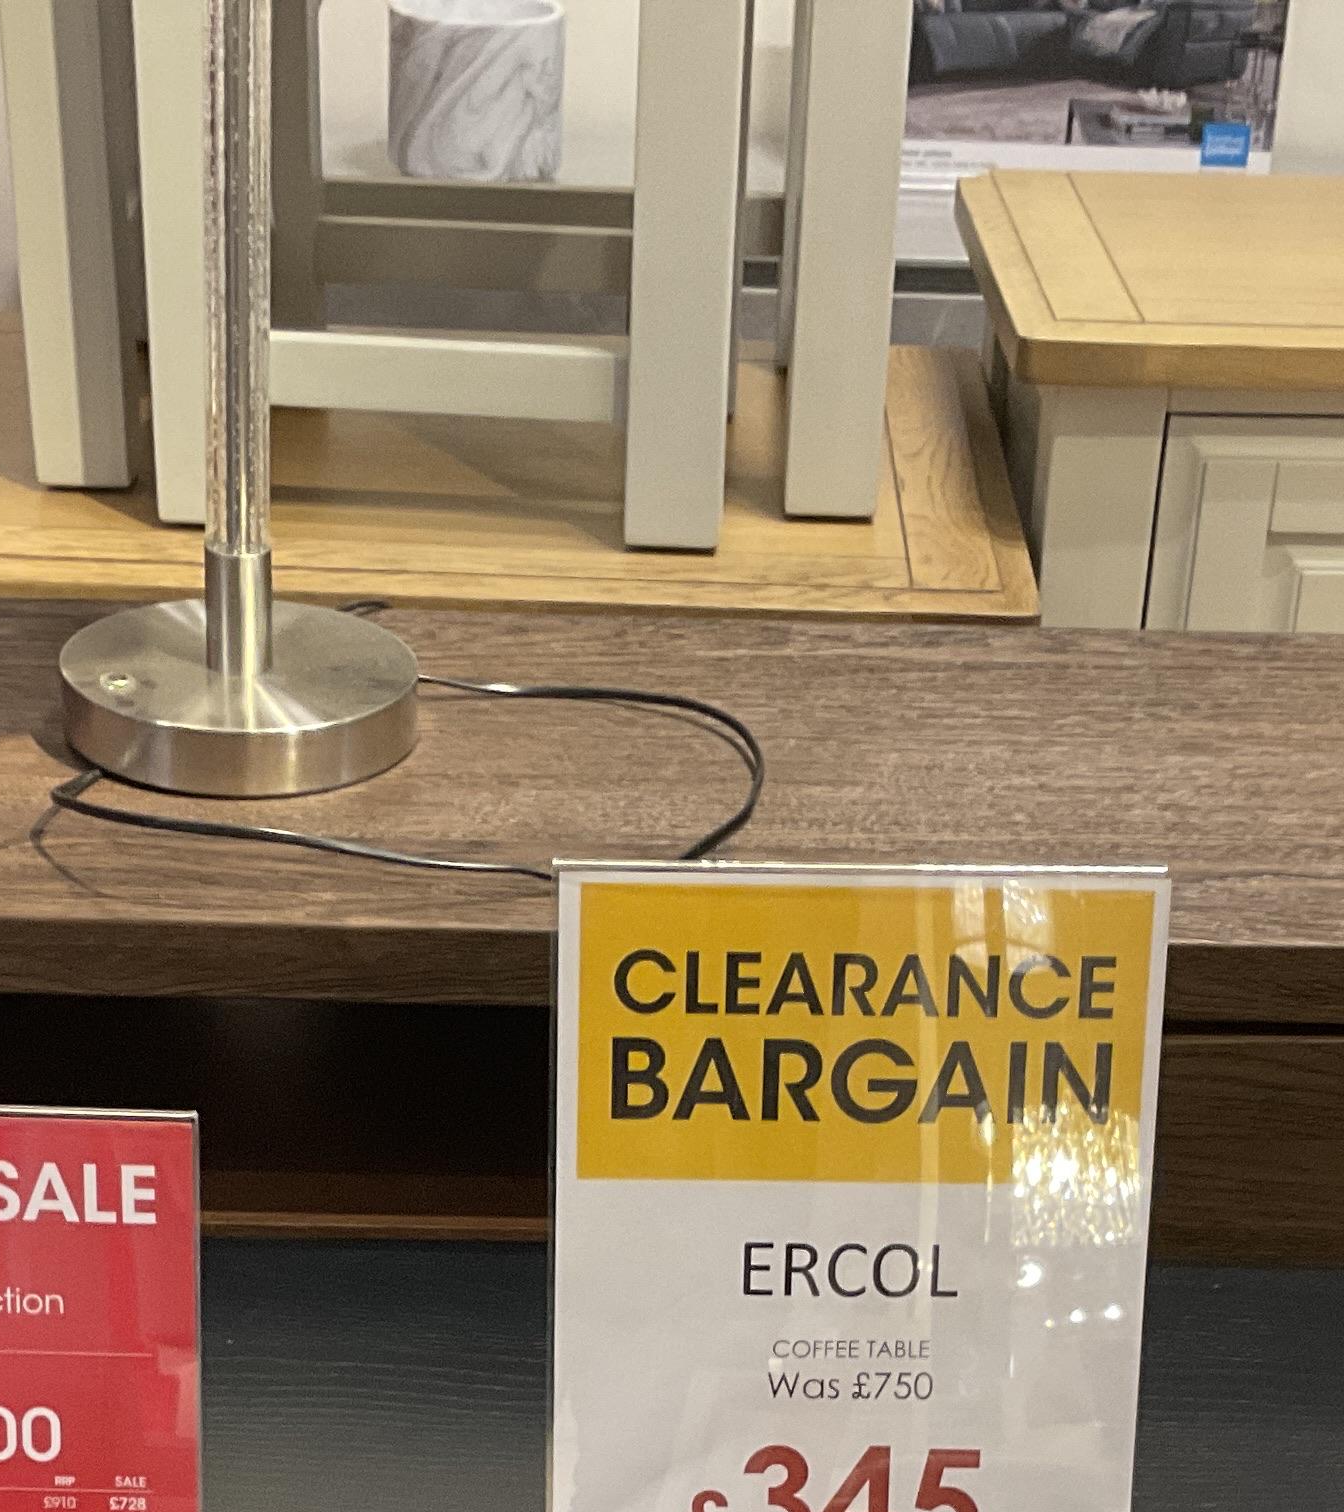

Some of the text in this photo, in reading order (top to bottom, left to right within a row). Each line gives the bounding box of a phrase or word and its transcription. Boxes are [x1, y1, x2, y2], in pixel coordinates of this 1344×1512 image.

[613, 949, 1117, 1019] CLEARANCE
[610, 1036, 1113, 1125] BARGAIN
[743, 1242, 958, 1298] ERCOL
[772, 1339, 930, 1359] COFFEE TABLE
[768, 1371, 933, 1400] Was £750
[54, 1475, 146, 1488] RRP SALE
[43, 1496, 146, 1511] £910 £728
